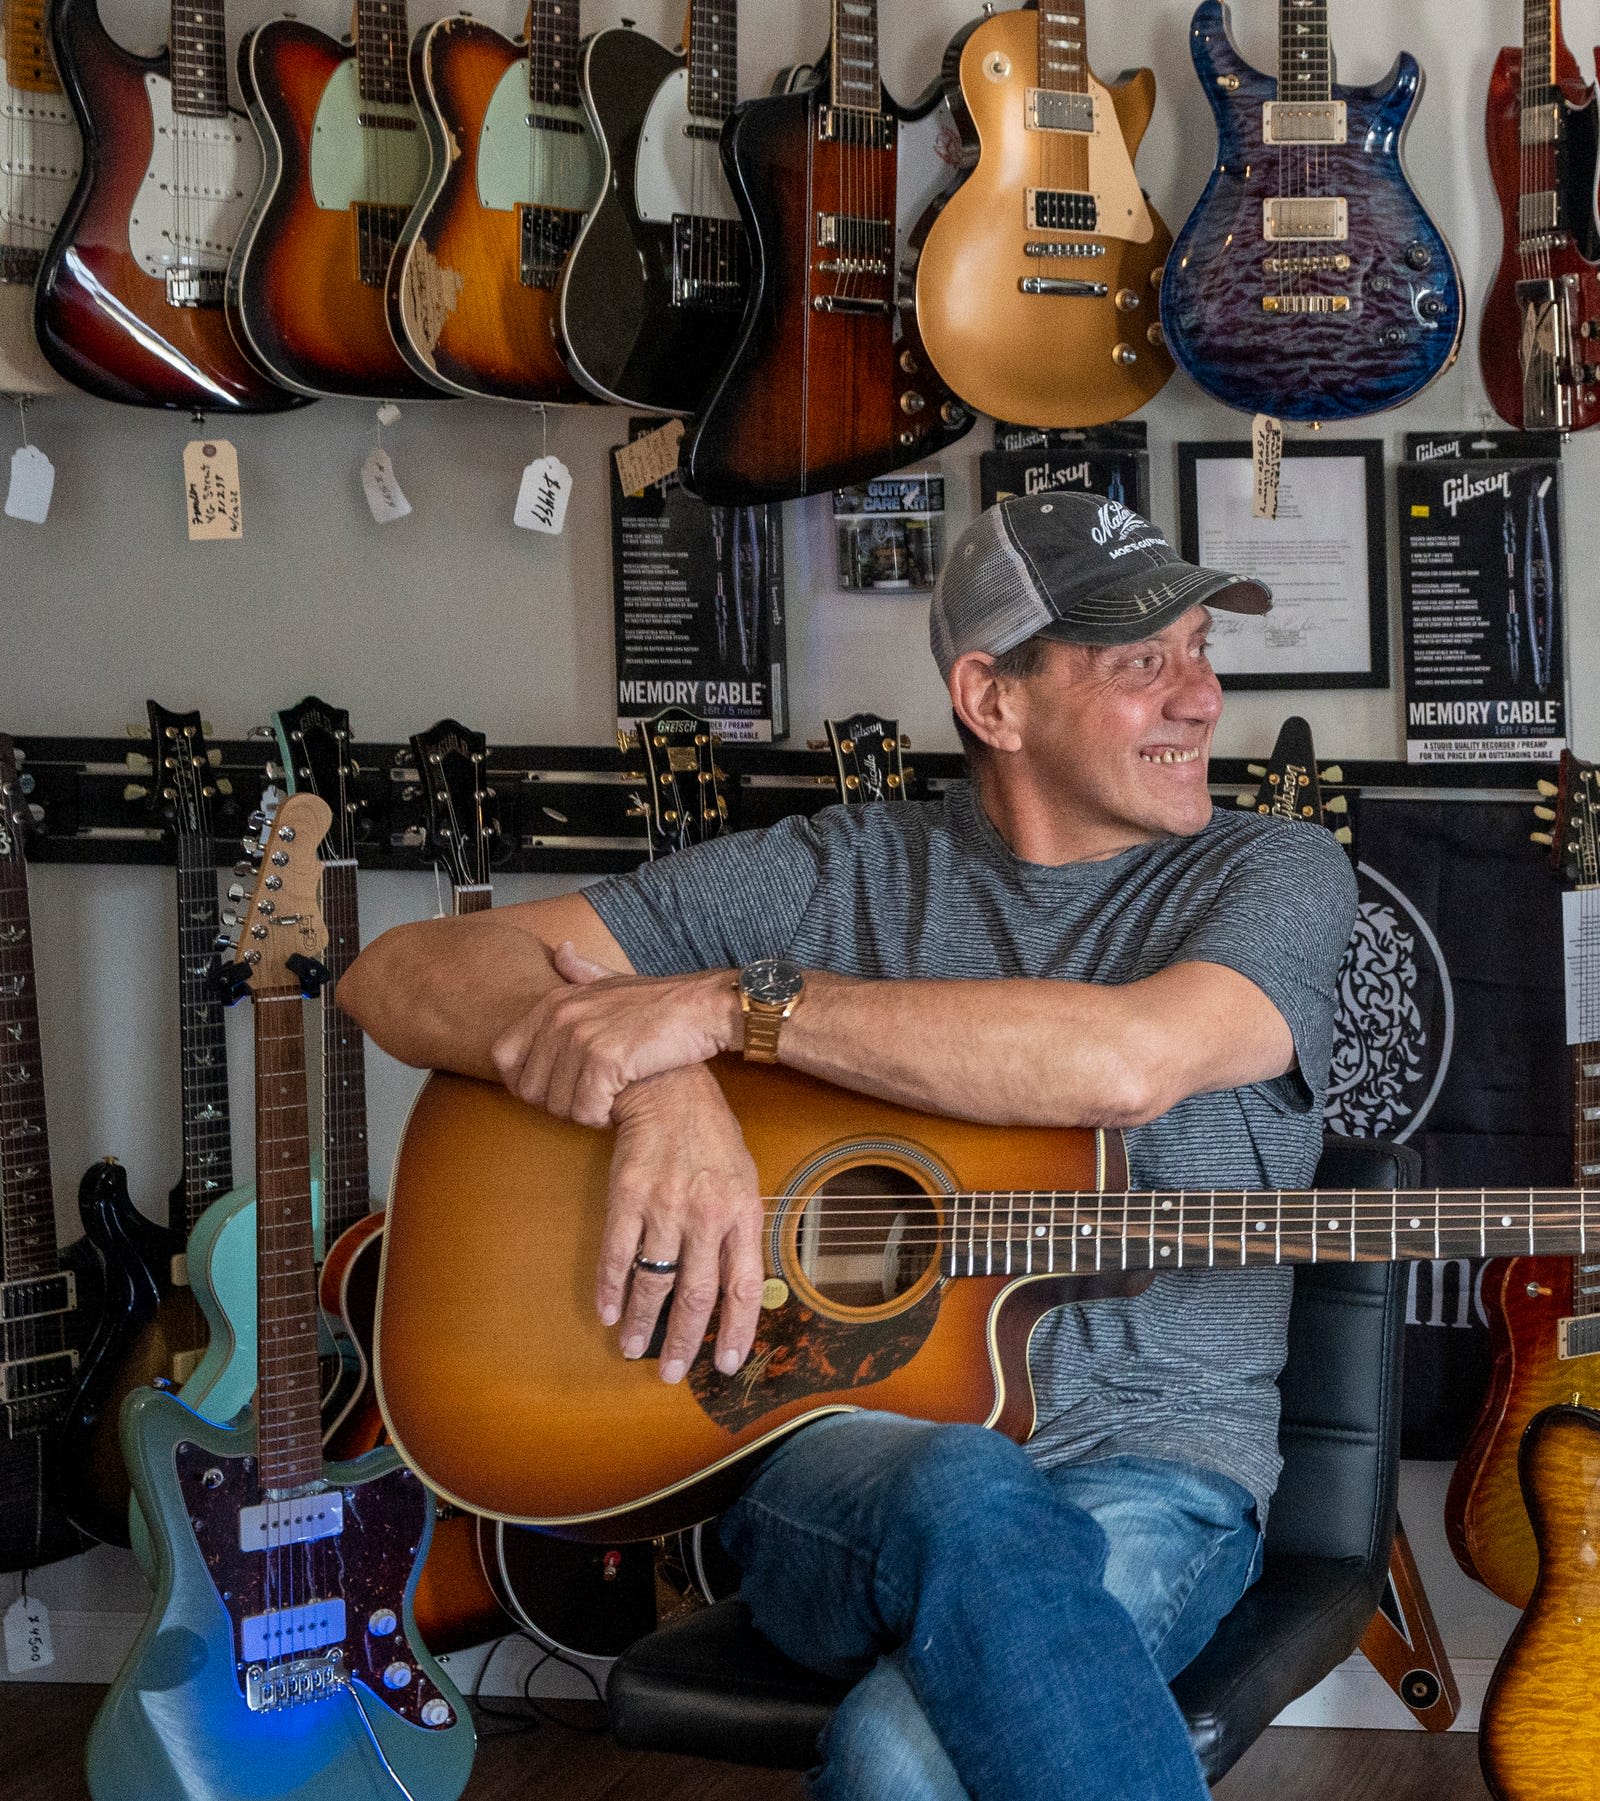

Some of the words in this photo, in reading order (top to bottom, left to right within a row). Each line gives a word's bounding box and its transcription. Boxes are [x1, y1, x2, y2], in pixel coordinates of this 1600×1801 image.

[1004, 432, 1049, 451] Gibson
[1416, 440, 1461, 462] Gibson
[1025, 461, 1092, 496] Gibson
[868, 482, 920, 497] GUITAR
[1442, 471, 1511, 517] Gibson
[863, 496, 900, 511] CARE
[903, 495, 928, 511] KIT
[619, 681, 703, 704] MEMORY
[704, 682, 763, 706] CABLE
[728, 706, 735, 716] 5
[737, 707, 762, 716] meter
[1409, 701, 1491, 725] MEMORY
[1496, 701, 1558, 725] CABLE
[657, 720, 698, 733] GRETSCH
[728, 721, 754, 729] PREAMP
[850, 722, 885, 744] Gibson
[1494, 725, 1514, 735] 16ft
[1521, 726, 1528, 734] 5
[1529, 726, 1556, 735] meter
[739, 731, 759, 739] CABLE
[1430, 742, 1453, 750] STUDIO
[1454, 742, 1480, 750] QUALITY
[1481, 741, 1515, 749] RECORDER
[1521, 741, 1548, 749] PREAMP
[1419, 752, 1432, 760] FOR
[1433, 752, 1446, 760] THE
[1447, 752, 1466, 760] PRICE
[1468, 752, 1477, 760] OF
[1478, 751, 1487, 759] AN
[1488, 751, 1532, 760] OUTSTANDING
[1533, 751, 1553, 759] CABLE
[862, 754, 886, 801] Lucille
[1272, 764, 1308, 820] Gibson
[28, 1615, 43, 1662] $4500
